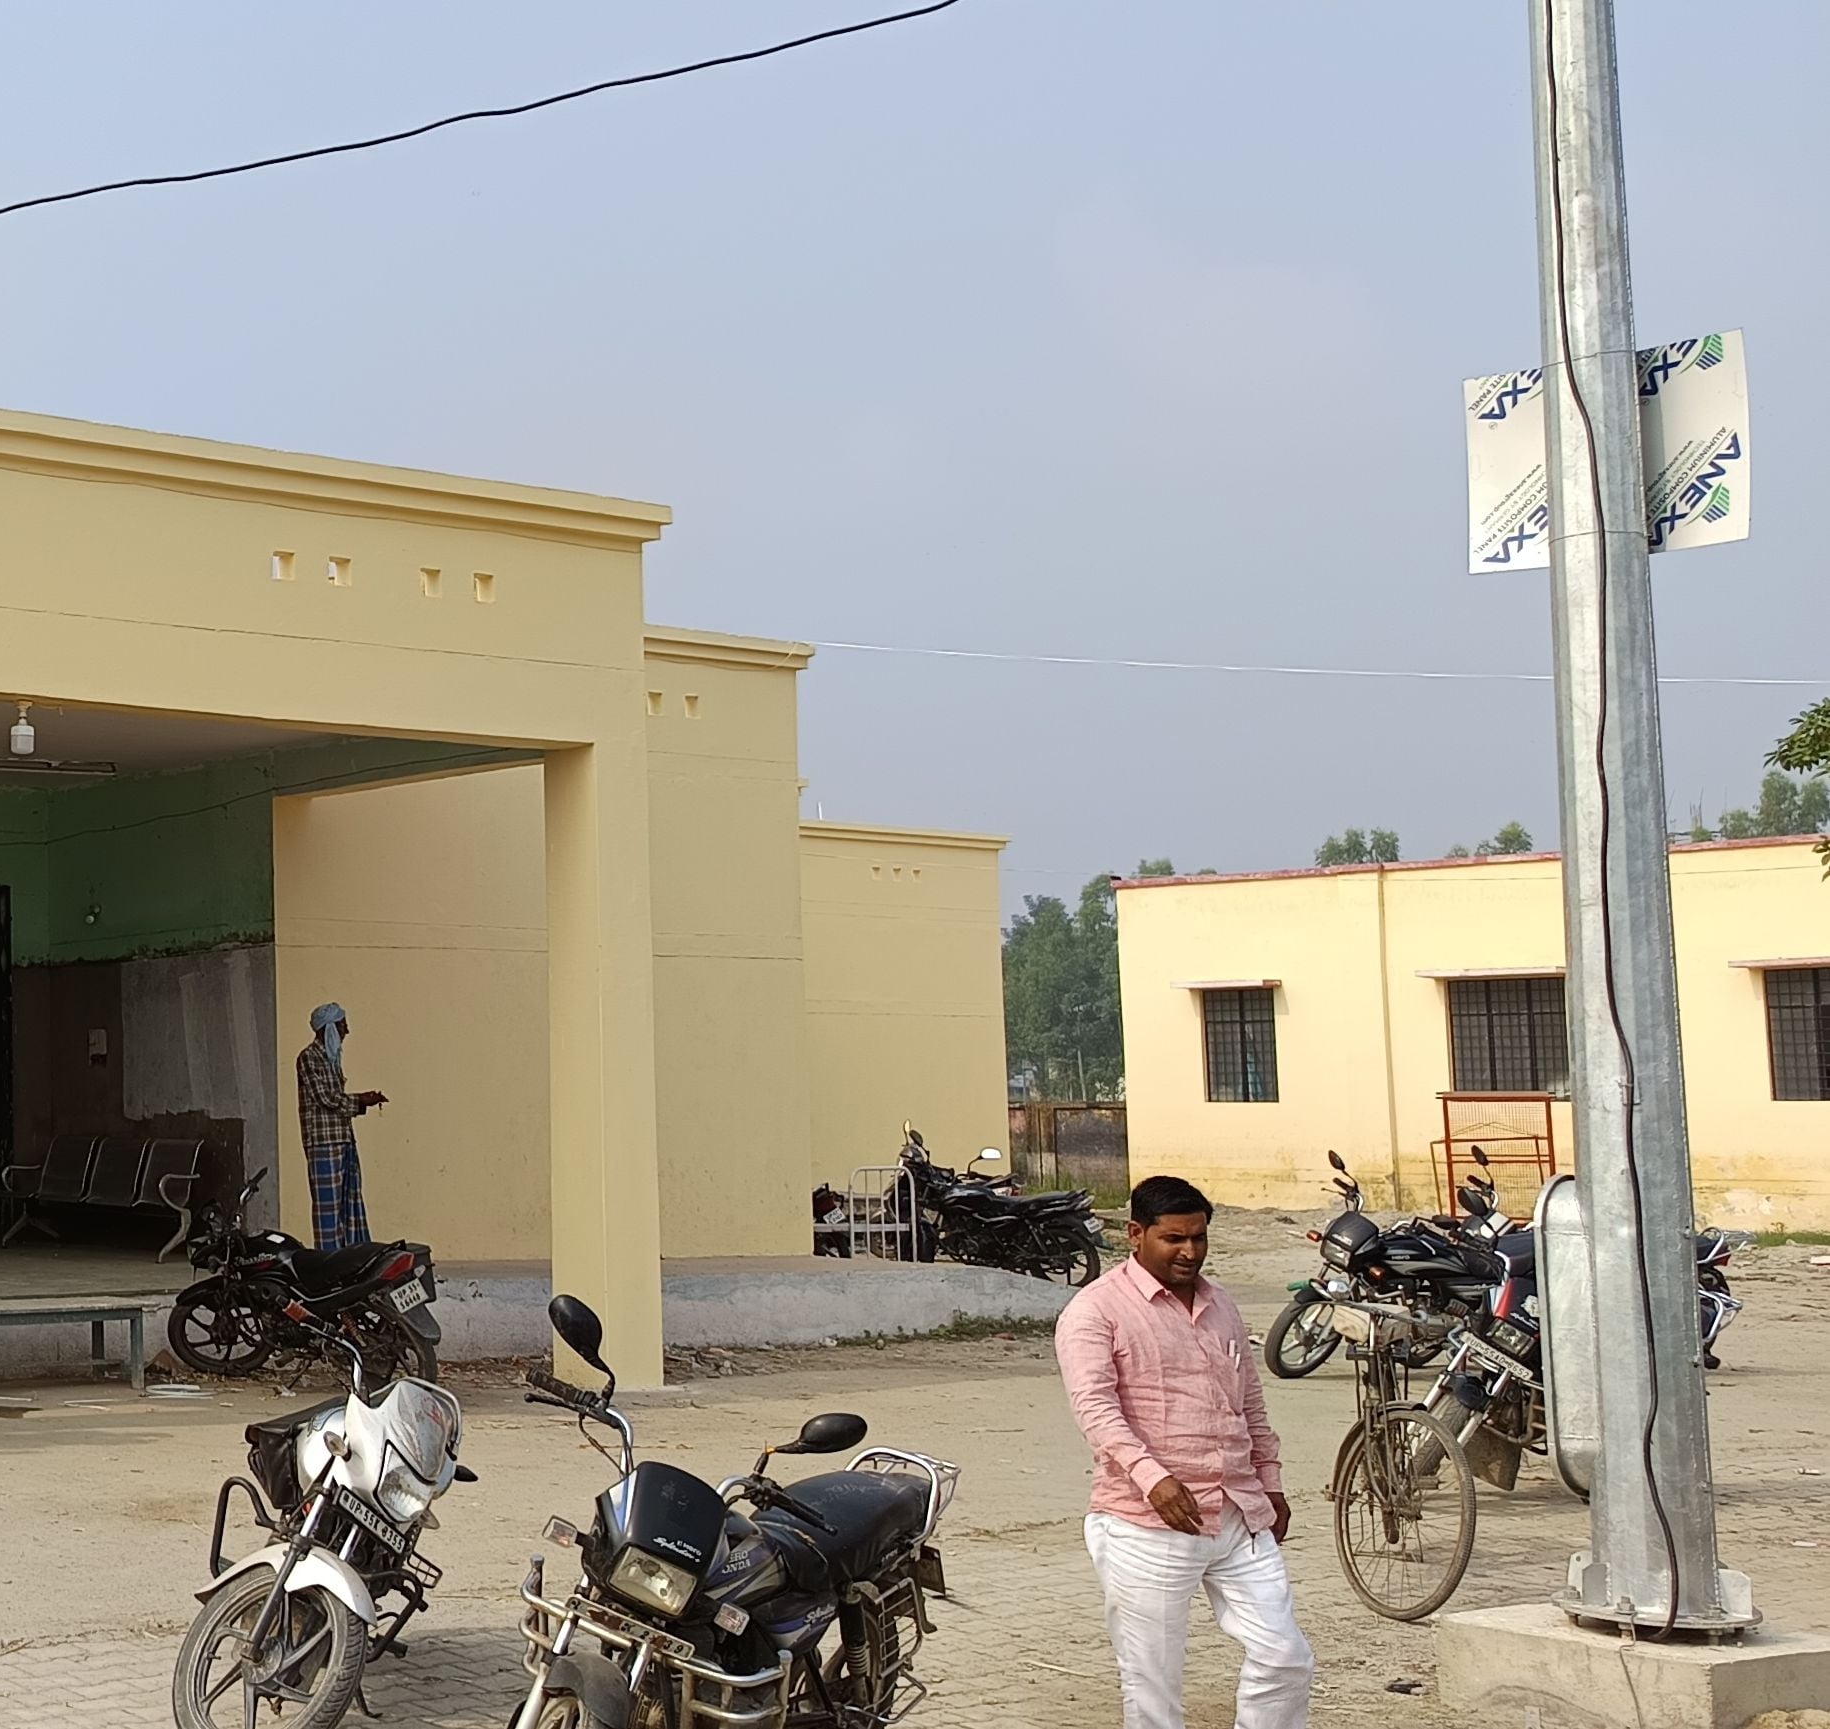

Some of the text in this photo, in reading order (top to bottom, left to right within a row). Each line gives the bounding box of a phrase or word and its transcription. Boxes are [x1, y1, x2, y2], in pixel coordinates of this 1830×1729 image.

[1477, 370, 1542, 419] EXA
[1639, 338, 1698, 396] EXA
[1467, 387, 1491, 411] PANEL
[1686, 425, 1725, 472] ALUMINIUM
[1648, 431, 1741, 547] ANEXA
[1472, 492, 1537, 554] COMPOSITE PANEL
[1481, 497, 1549, 562] EXA
